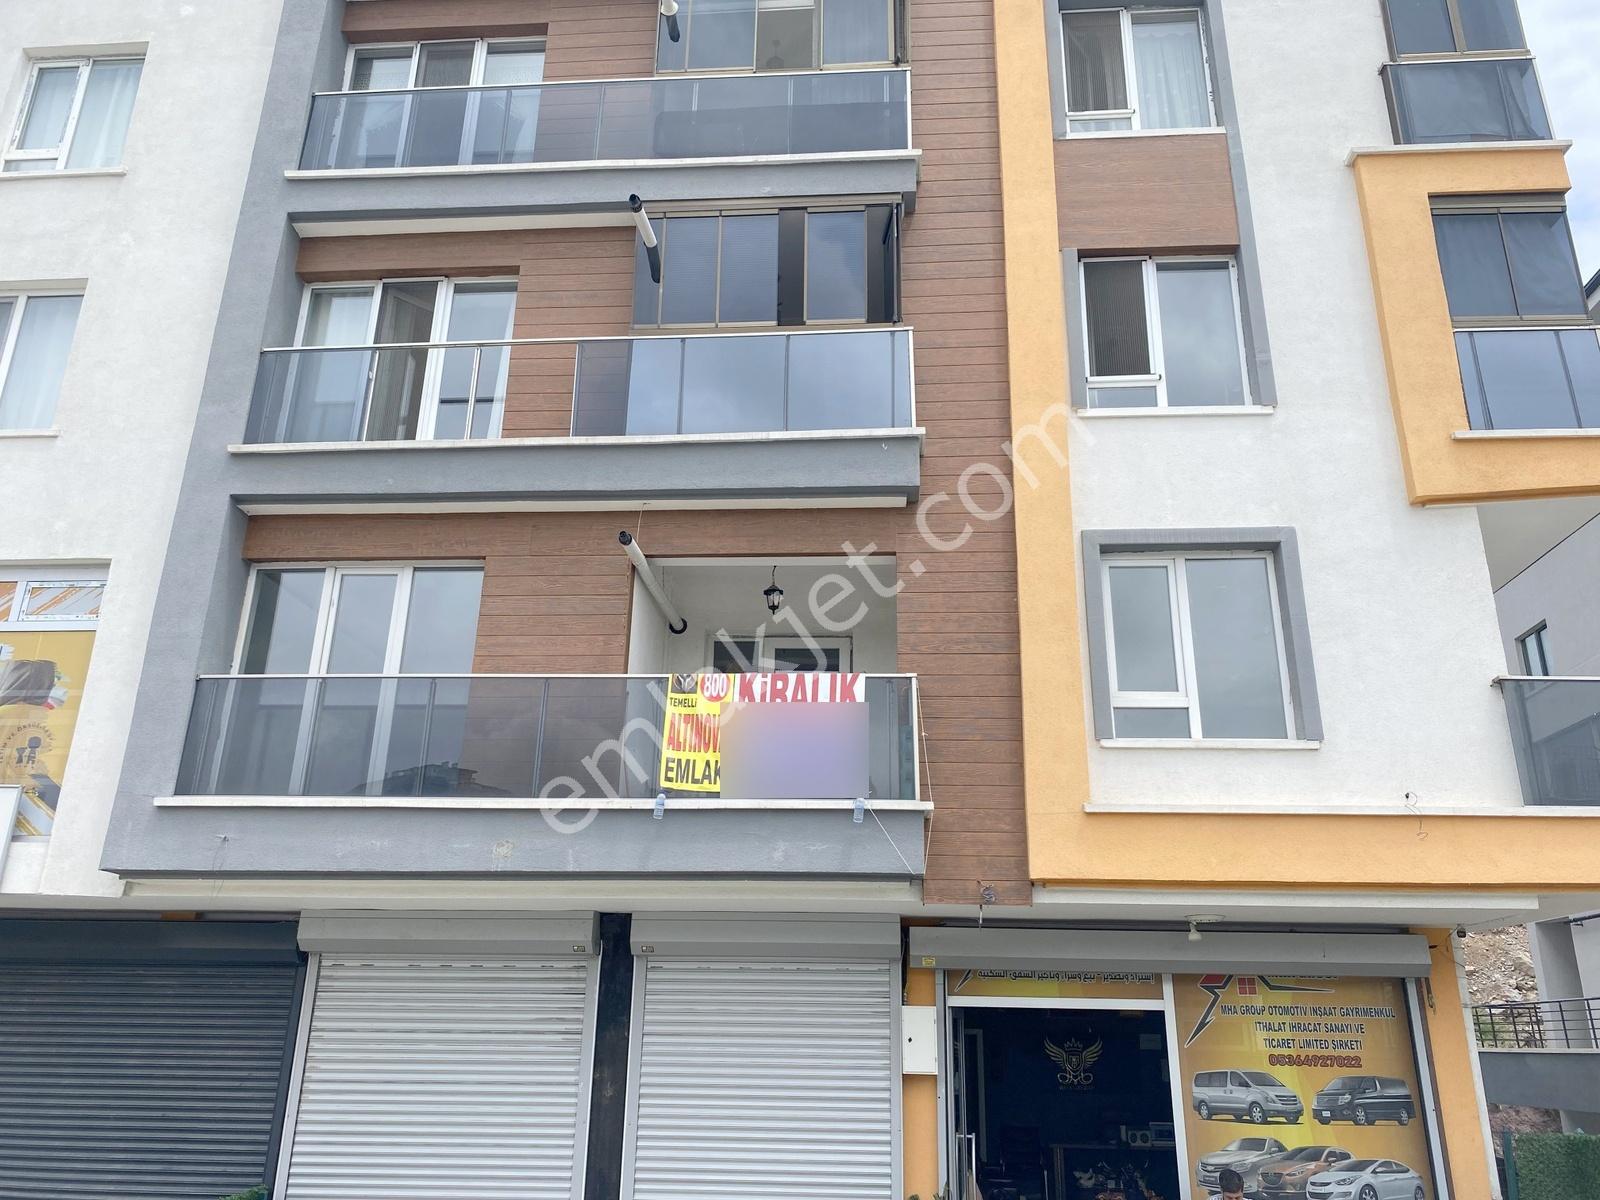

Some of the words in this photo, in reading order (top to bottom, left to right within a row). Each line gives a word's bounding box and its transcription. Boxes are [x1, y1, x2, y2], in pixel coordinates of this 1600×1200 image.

[703, 673, 727, 697] 800
[667, 712, 720, 753] ALTINOV
[1220, 1004, 1239, 1016] MHA
[1240, 1004, 1266, 1016] GROUP
[1354, 1023, 1366, 1034] VE
[1268, 1053, 1363, 1069] 05364927022
